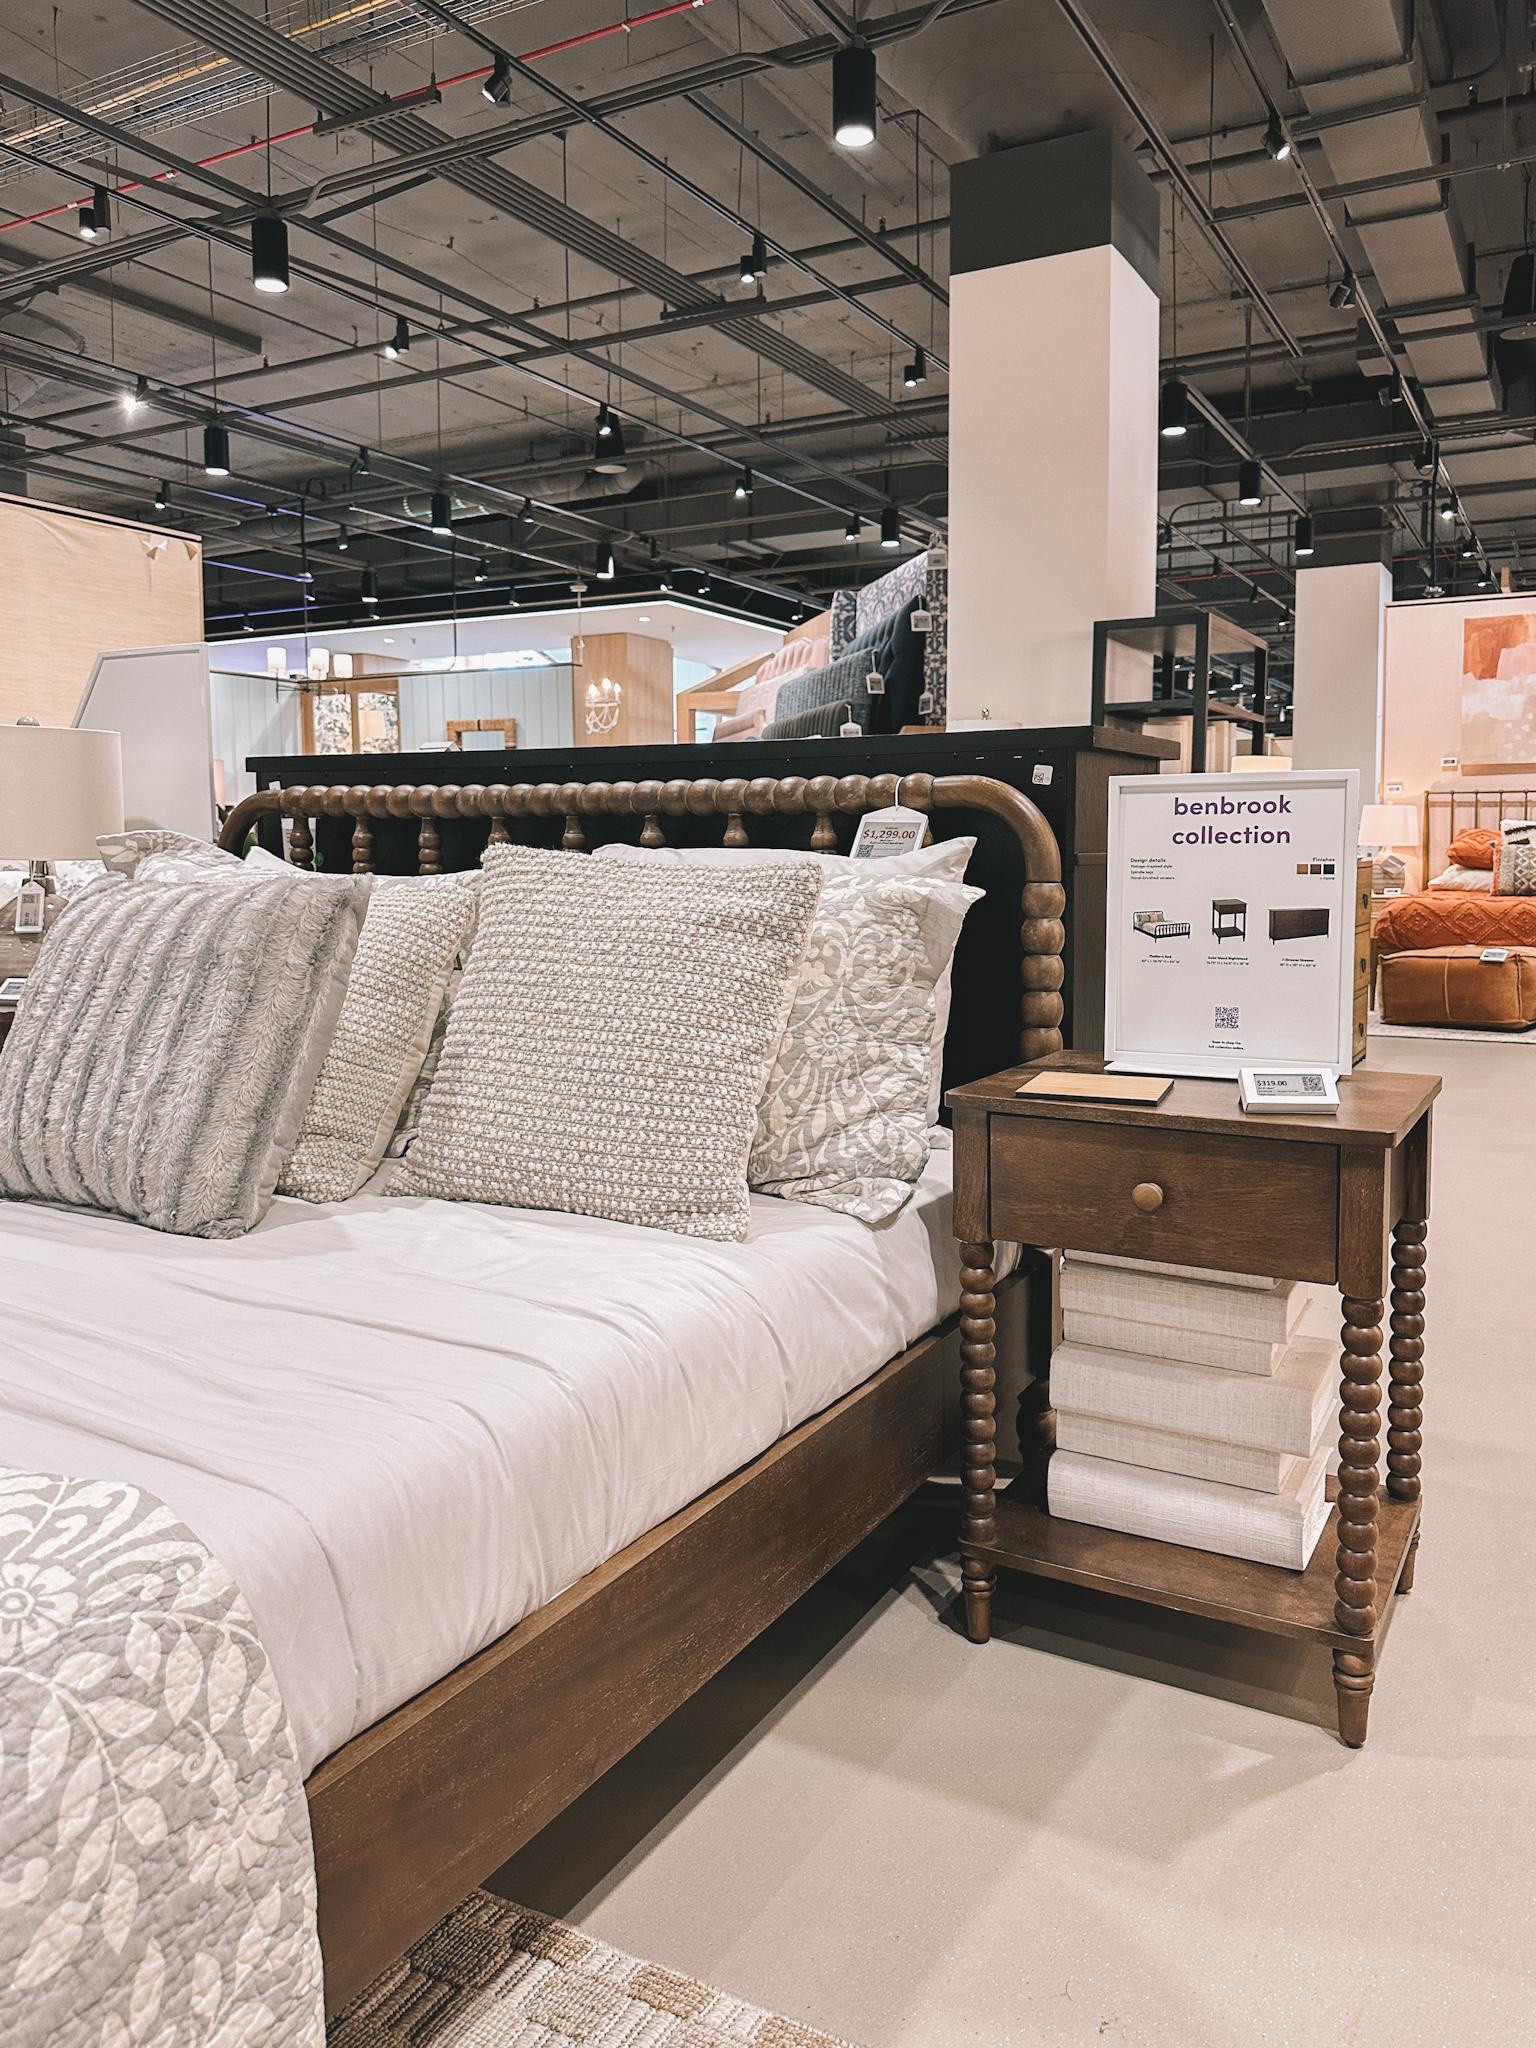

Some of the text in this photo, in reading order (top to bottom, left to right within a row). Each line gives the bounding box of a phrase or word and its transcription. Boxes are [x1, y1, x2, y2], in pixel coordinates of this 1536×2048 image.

[1174, 794, 1292, 816] benbrook
[863, 829, 916, 840] $1,299.00
[1172, 825, 1291, 846] collection
